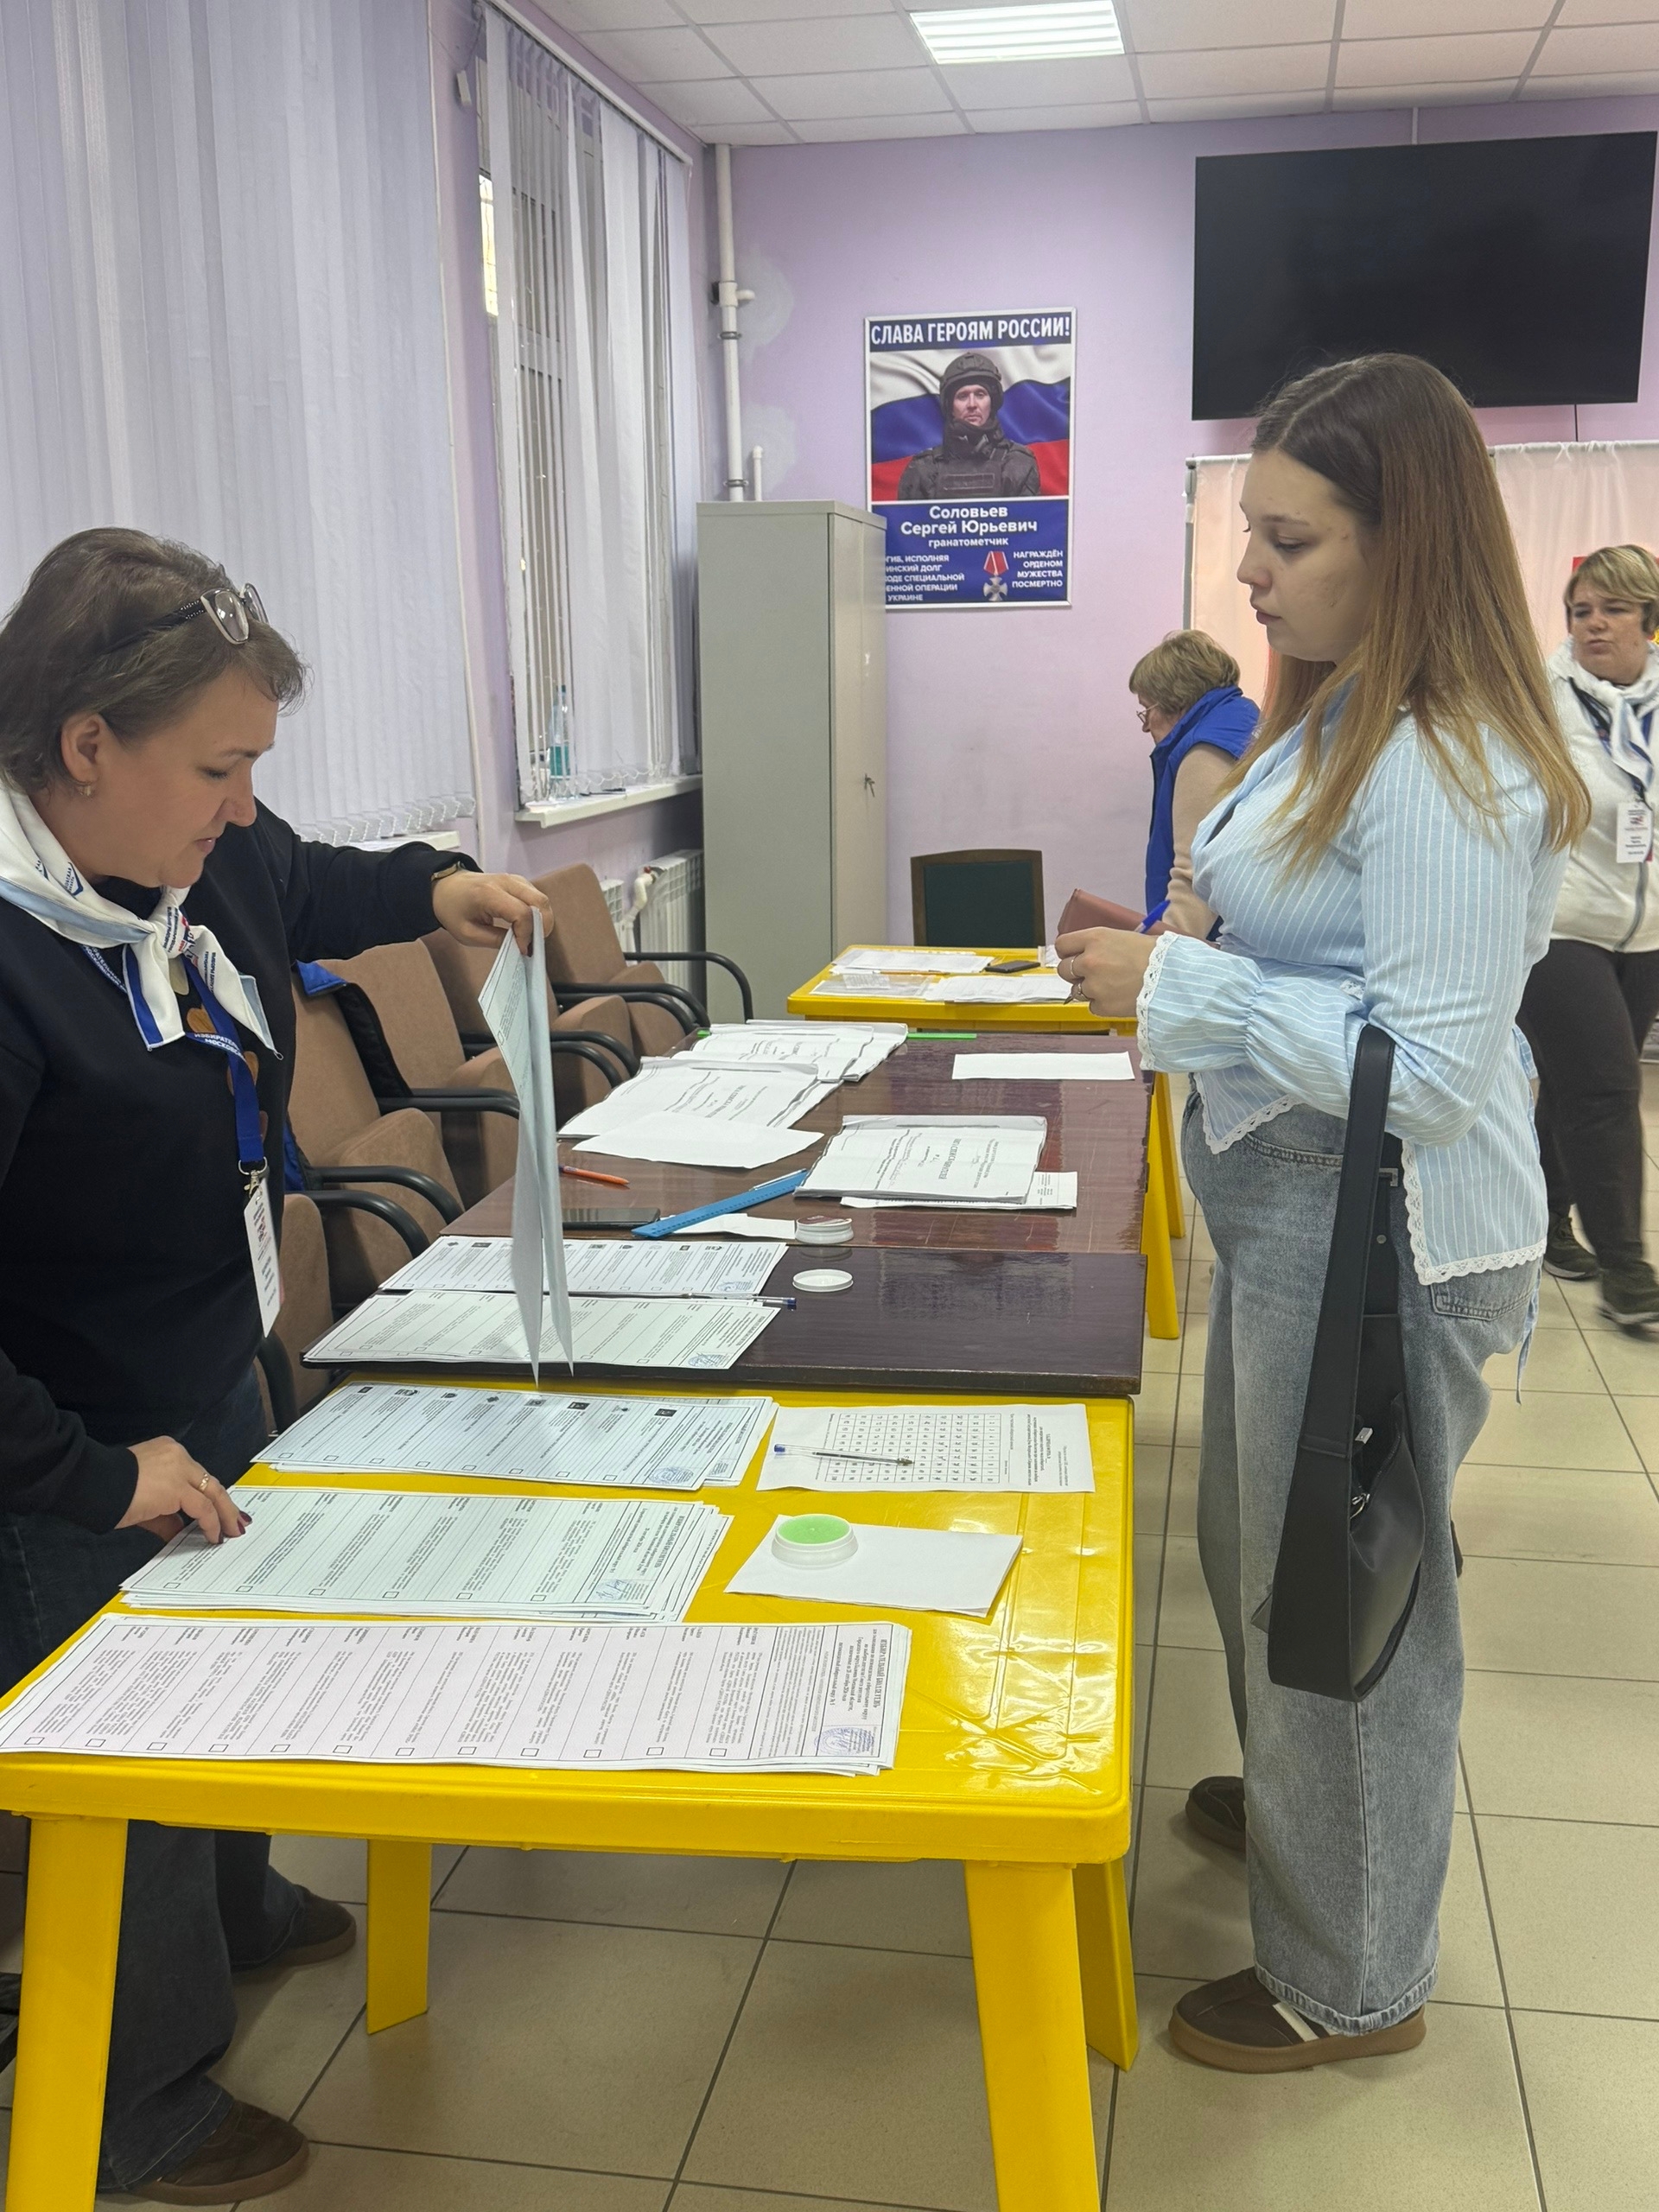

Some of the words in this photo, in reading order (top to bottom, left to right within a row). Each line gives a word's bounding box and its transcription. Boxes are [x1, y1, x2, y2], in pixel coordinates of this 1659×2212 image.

[871, 324, 925, 345] СЛАВА
[928, 321, 993, 342] ГЕРОЯМ
[998, 317, 1071, 339] РОССИИ!
[929, 505, 1008, 519] Соловьев
[900, 521, 957, 537] Сергей
[962, 520, 1038, 536] Юрьевич
[928, 537, 1009, 549] гранатометчик
[885, 555, 904, 563] ГИБ,
[1013, 549, 1064, 559] НАГРАЖДЁН
[920, 564, 943, 573] ДОЛГ
[1023, 560, 1064, 569] ОРДЕНОМ
[904, 573, 965, 582] СПЕЦИАЛЬНОЙ
[915, 583, 958, 593] ОПЕРАЦИИ
[1012, 580, 1064, 588] ПОСМЕРТНО
